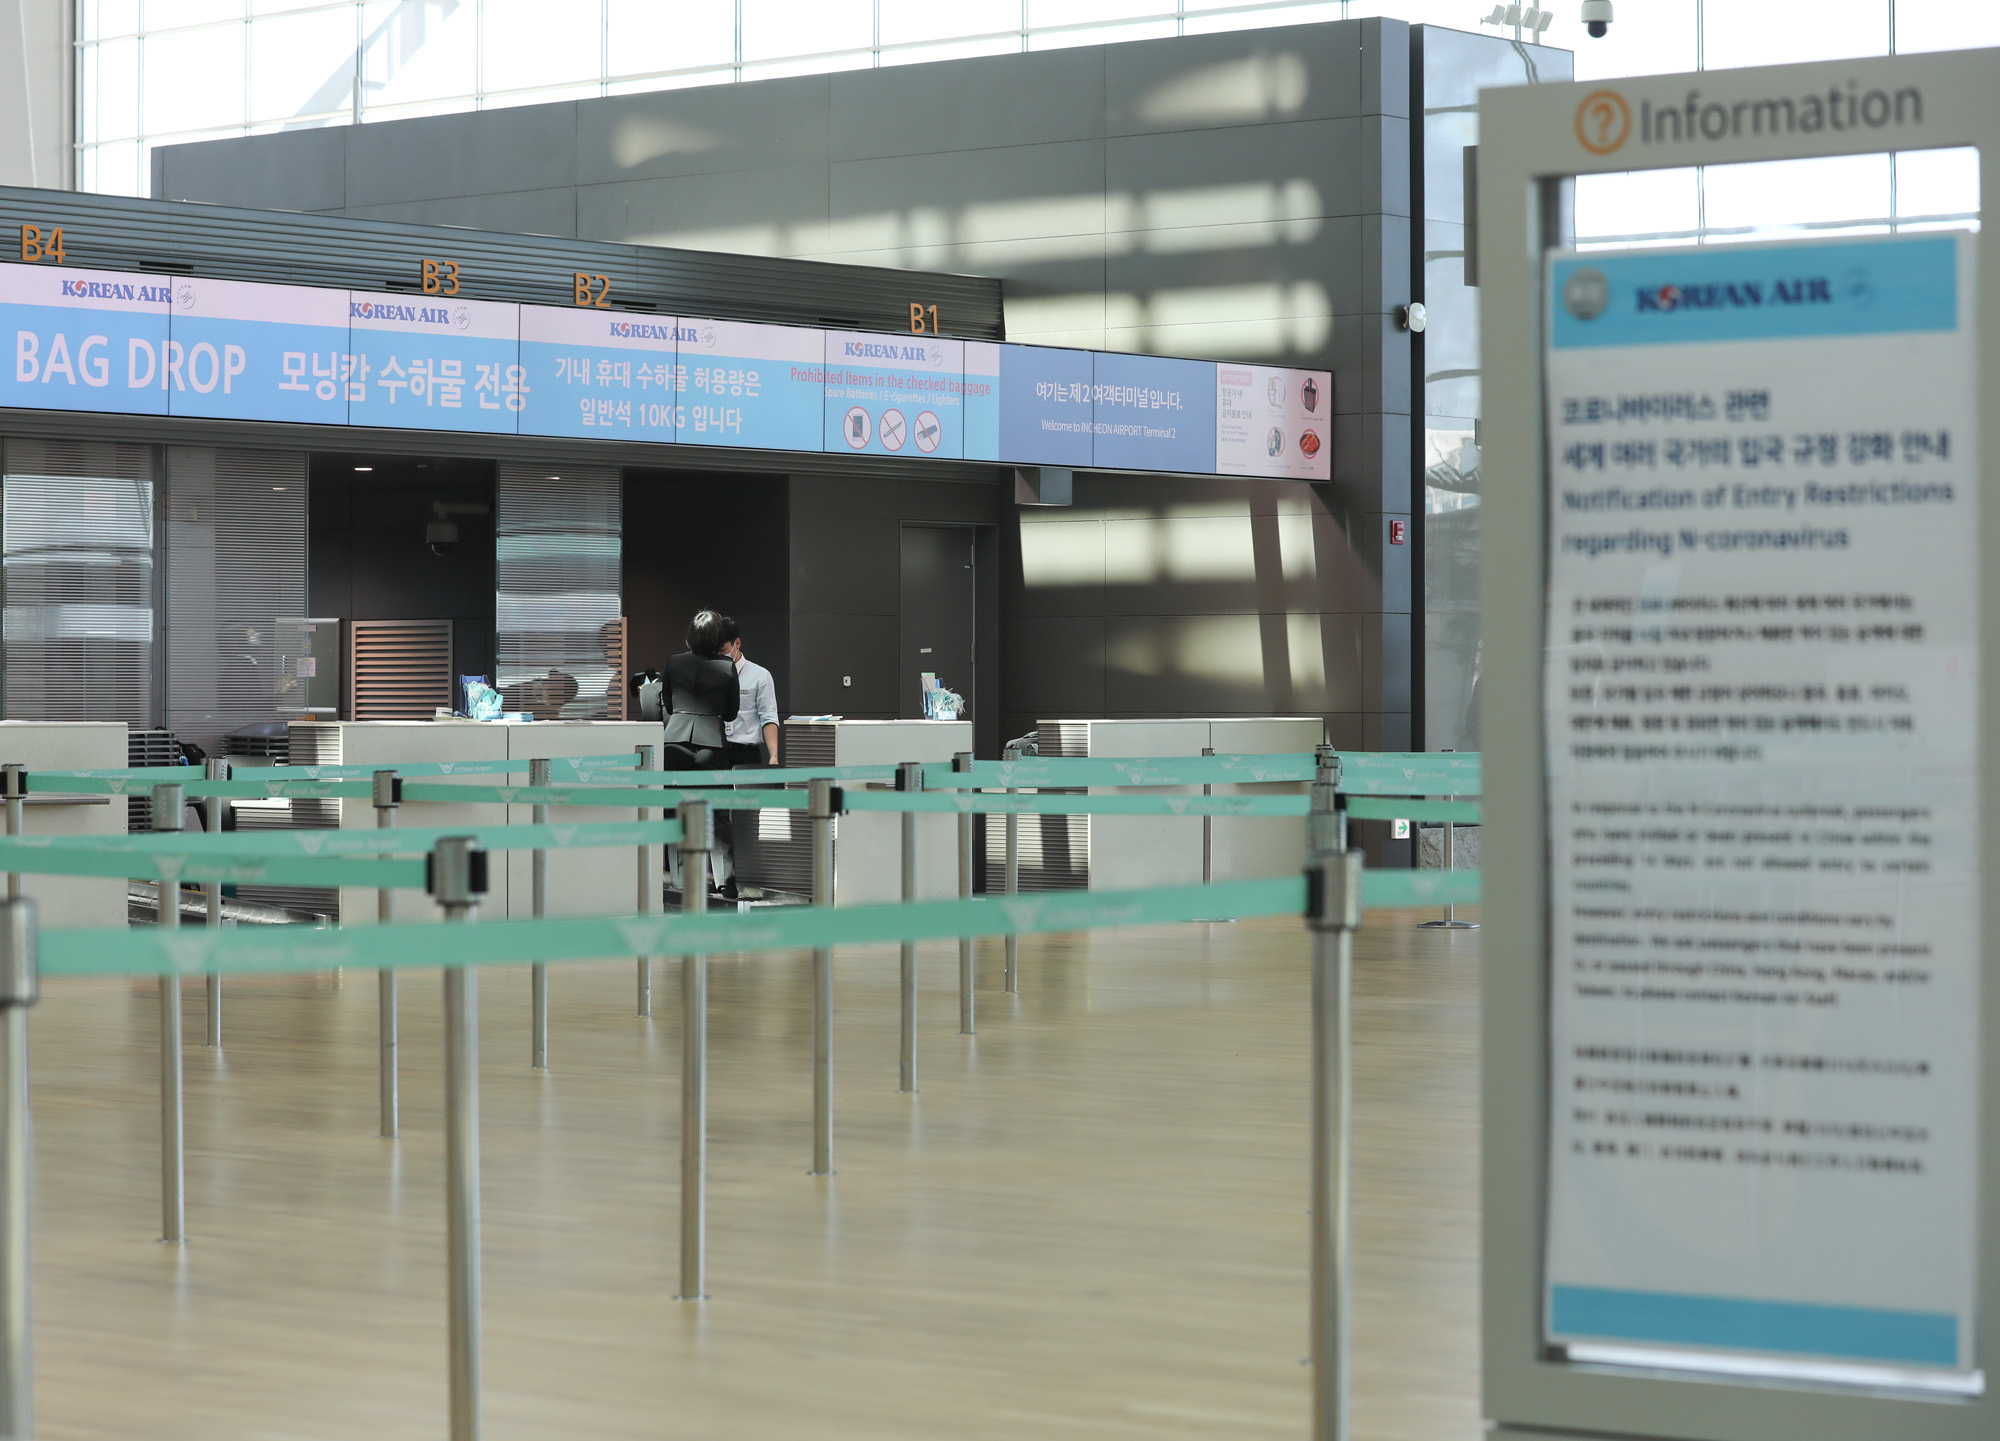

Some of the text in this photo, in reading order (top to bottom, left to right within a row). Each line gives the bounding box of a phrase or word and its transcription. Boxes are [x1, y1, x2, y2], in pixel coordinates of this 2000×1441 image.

[1640, 80, 1924, 144] Information
[20, 224, 66, 264] B4
[61, 279, 136, 302] KOREAN
[136, 284, 173, 304] AIR
[420, 258, 461, 296] B3
[573, 272, 611, 308] B2
[1635, 277, 1834, 313] KOREAN AIR
[350, 301, 416, 322] KOREAN
[417, 305, 450, 325] AIR
[909, 302, 939, 335] B1
[609, 321, 699, 343] KOREAN AIR
[15, 329, 246, 395] BAG DROP
[844, 341, 927, 362] KOREAN AIR
[278, 350, 530, 413] 모닝캄 수하물 전용
[555, 356, 762, 398] 기내 휴대 수하물 허용량은
[790, 366, 991, 397] Prohibited Items in the checked baggage
[1036, 380, 1069, 402] 여기는
[823, 386, 845, 399] Spare
[846, 387, 878, 400] Batteries
[884, 390, 926, 404] E-cigarettes
[932, 393, 960, 407] Lighters
[1561, 389, 1771, 425] 코로나바이러스 관련
[580, 398, 743, 434] 일반석 10KG 입니다
[1041, 419, 1176, 439] Welcome to INCHEON AIRPORT Terminal 2
[1563, 477, 1955, 513] Notification of Entry Restrictions
[1563, 524, 1850, 557] regarding N-coronavirus
[321, 768, 360, 777] Incheon Airport
[455, 764, 492, 773] Incheon Airport
